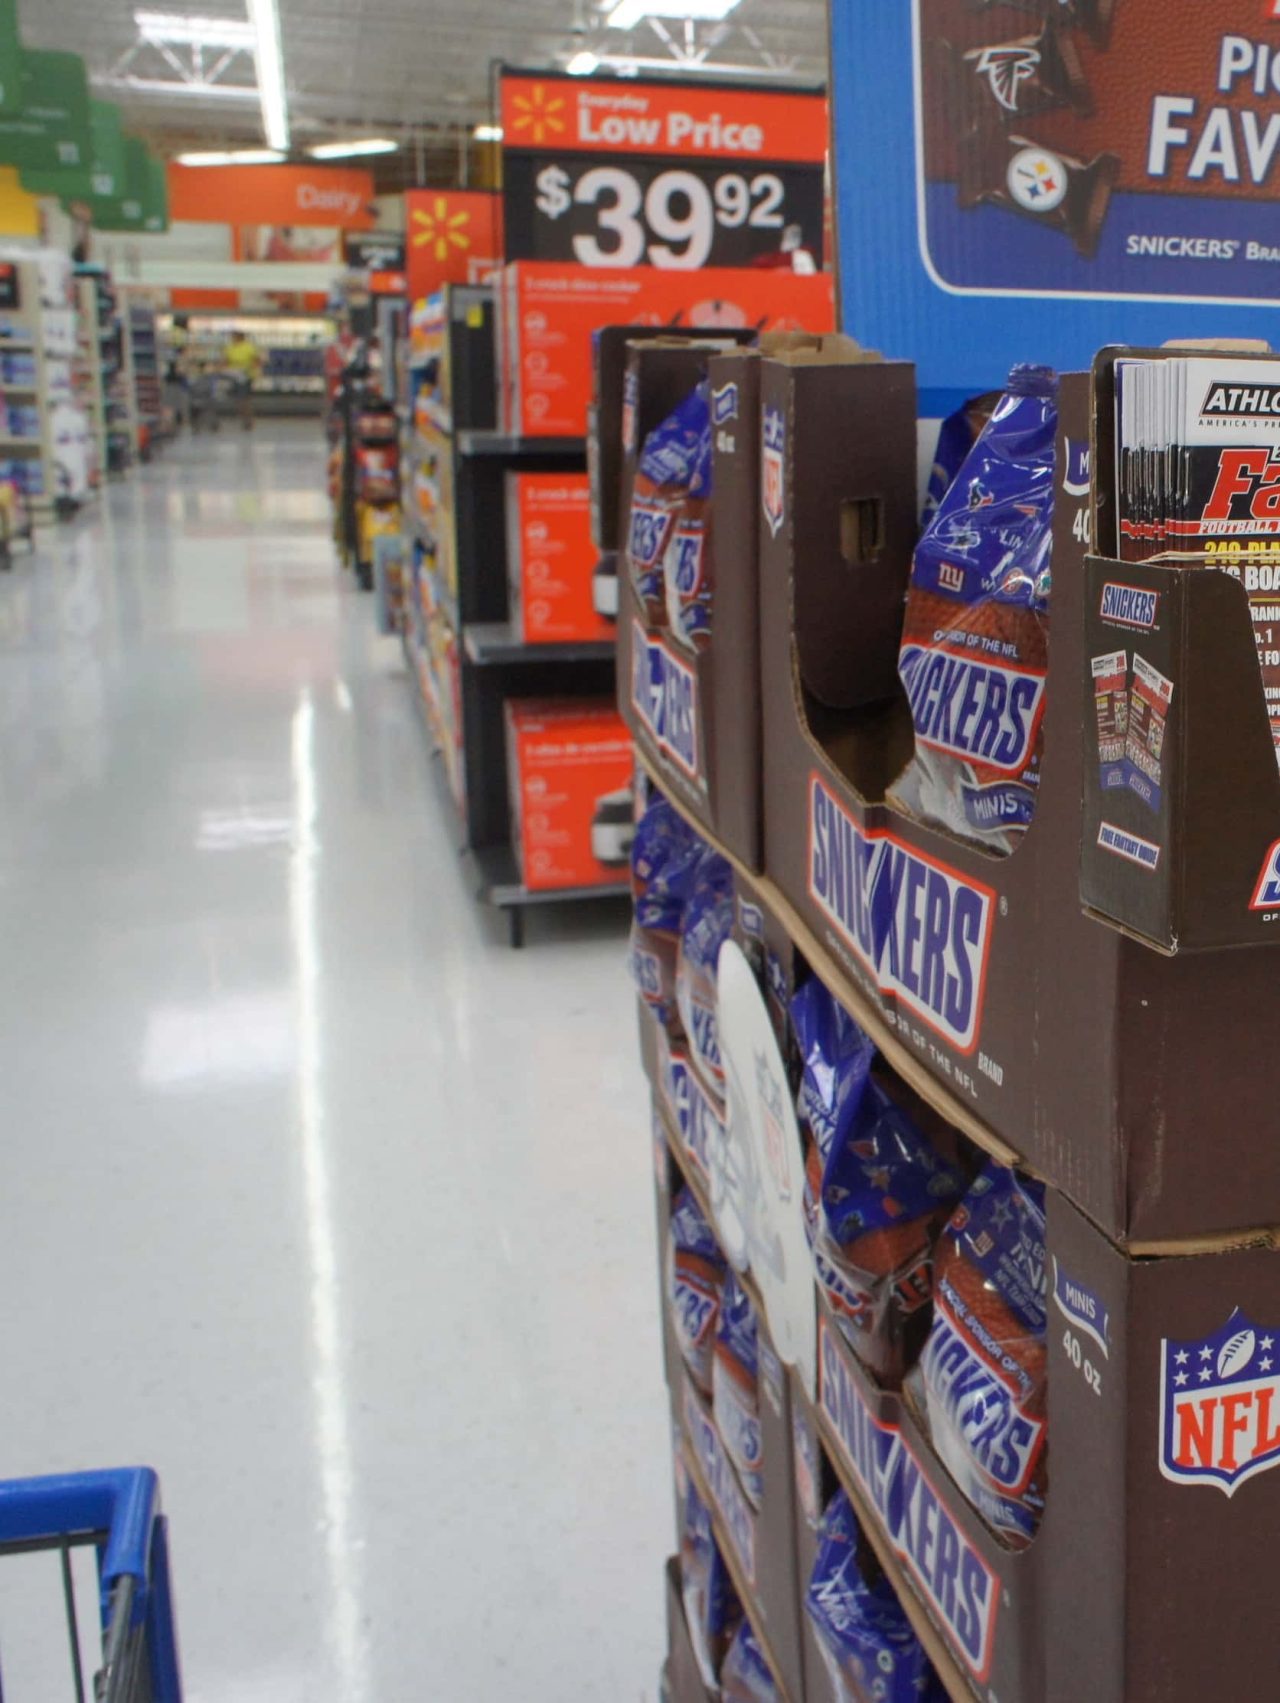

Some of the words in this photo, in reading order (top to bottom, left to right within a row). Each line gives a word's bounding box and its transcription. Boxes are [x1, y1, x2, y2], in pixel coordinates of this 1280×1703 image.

[578, 93, 648, 112] Everyday
[578, 107, 662, 144] Low
[668, 112, 764, 151] Price
[297, 185, 361, 213] Dairy
[1199, 419, 1260, 430] AMERICA'S
[1198, 519, 1275, 534] FOOTBALL
[1102, 586, 1156, 624] SNICKERS
[981, 638, 1000, 651] THE
[1002, 643, 1019, 658] NFL
[974, 793, 1018, 820] MINIS
[955, 1067, 978, 1098] NFL
[978, 1051, 1004, 1087] BRAND
[1066, 1282, 1097, 1320] MINIS
[1062, 1329, 1081, 1370] 40
[1083, 1362, 1102, 1397] oz
